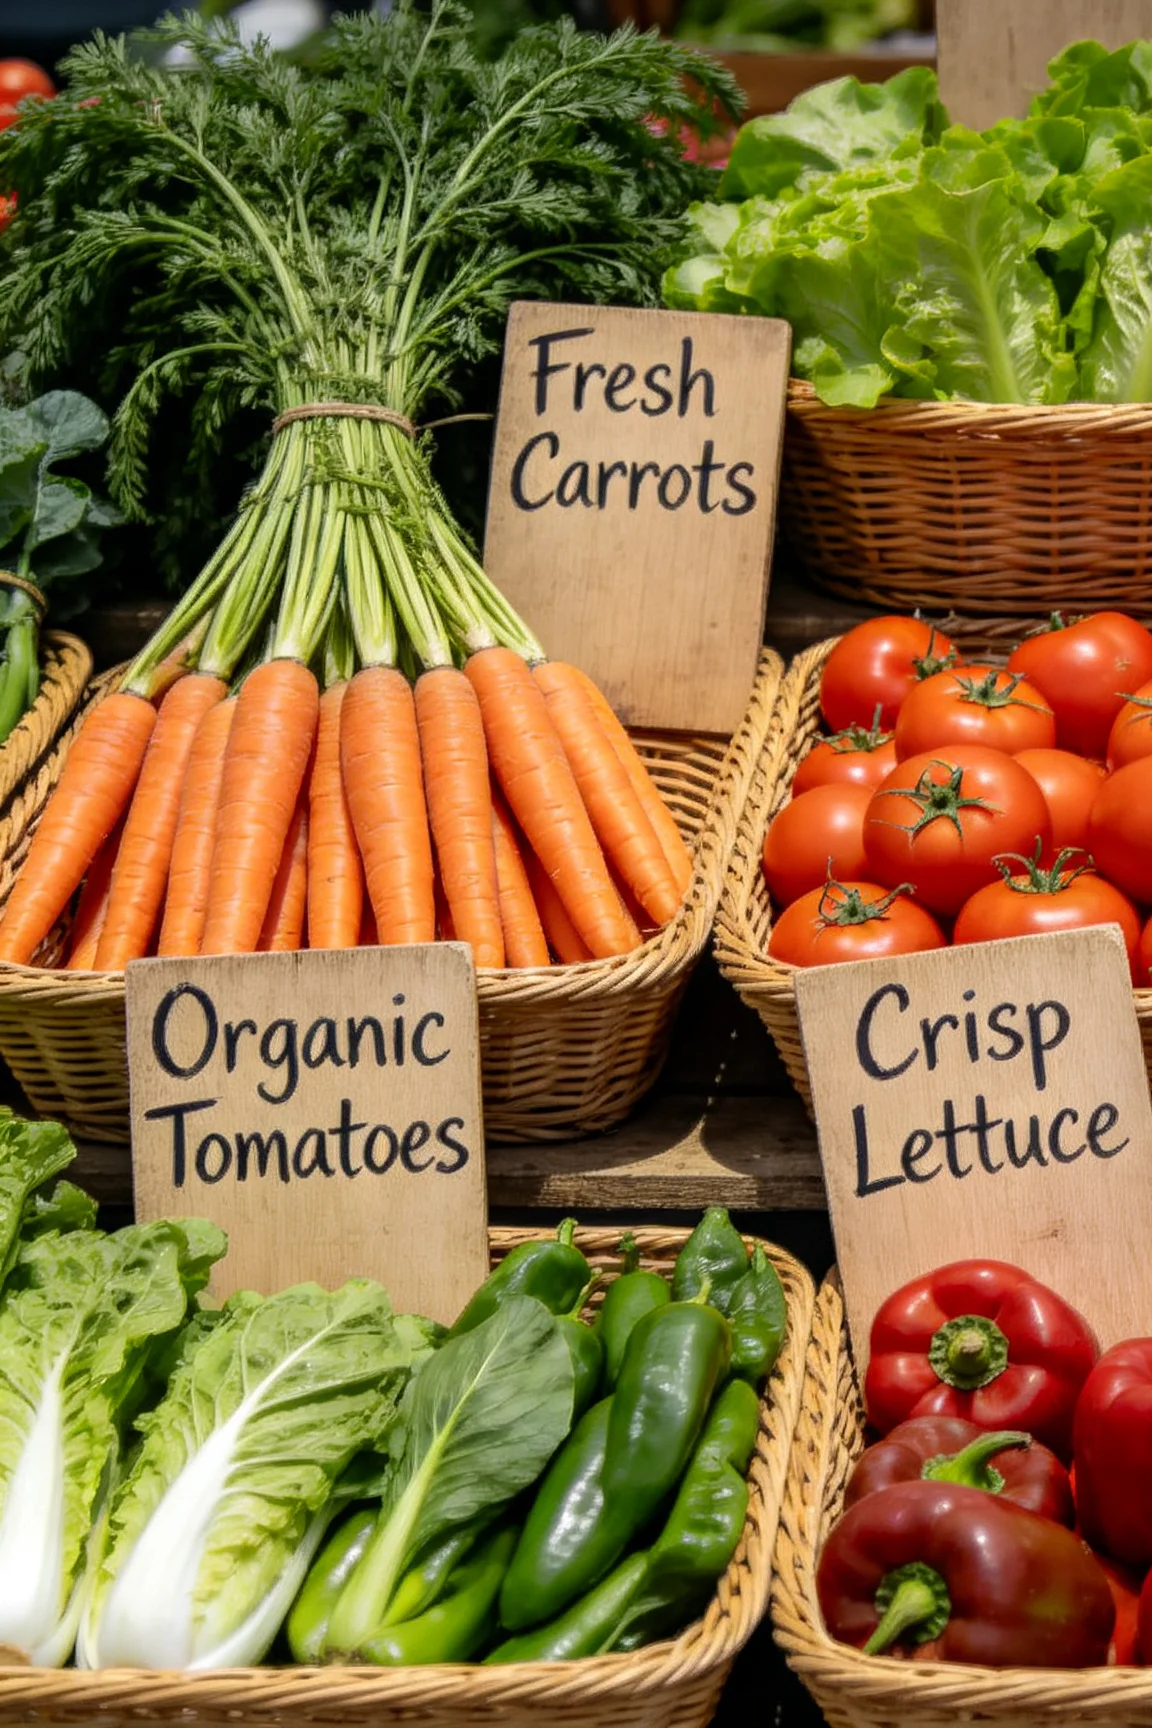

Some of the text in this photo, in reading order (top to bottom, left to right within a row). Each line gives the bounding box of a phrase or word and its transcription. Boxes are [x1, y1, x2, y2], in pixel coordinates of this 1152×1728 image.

[527, 328, 716, 417] Fresh
[510, 431, 758, 516] Carrots
[151, 982, 451, 1105] Organic
[855, 983, 1071, 1091] Crisp
[145, 1097, 470, 1188] Tomatoes
[853, 1093, 1130, 1198] Lettuce
